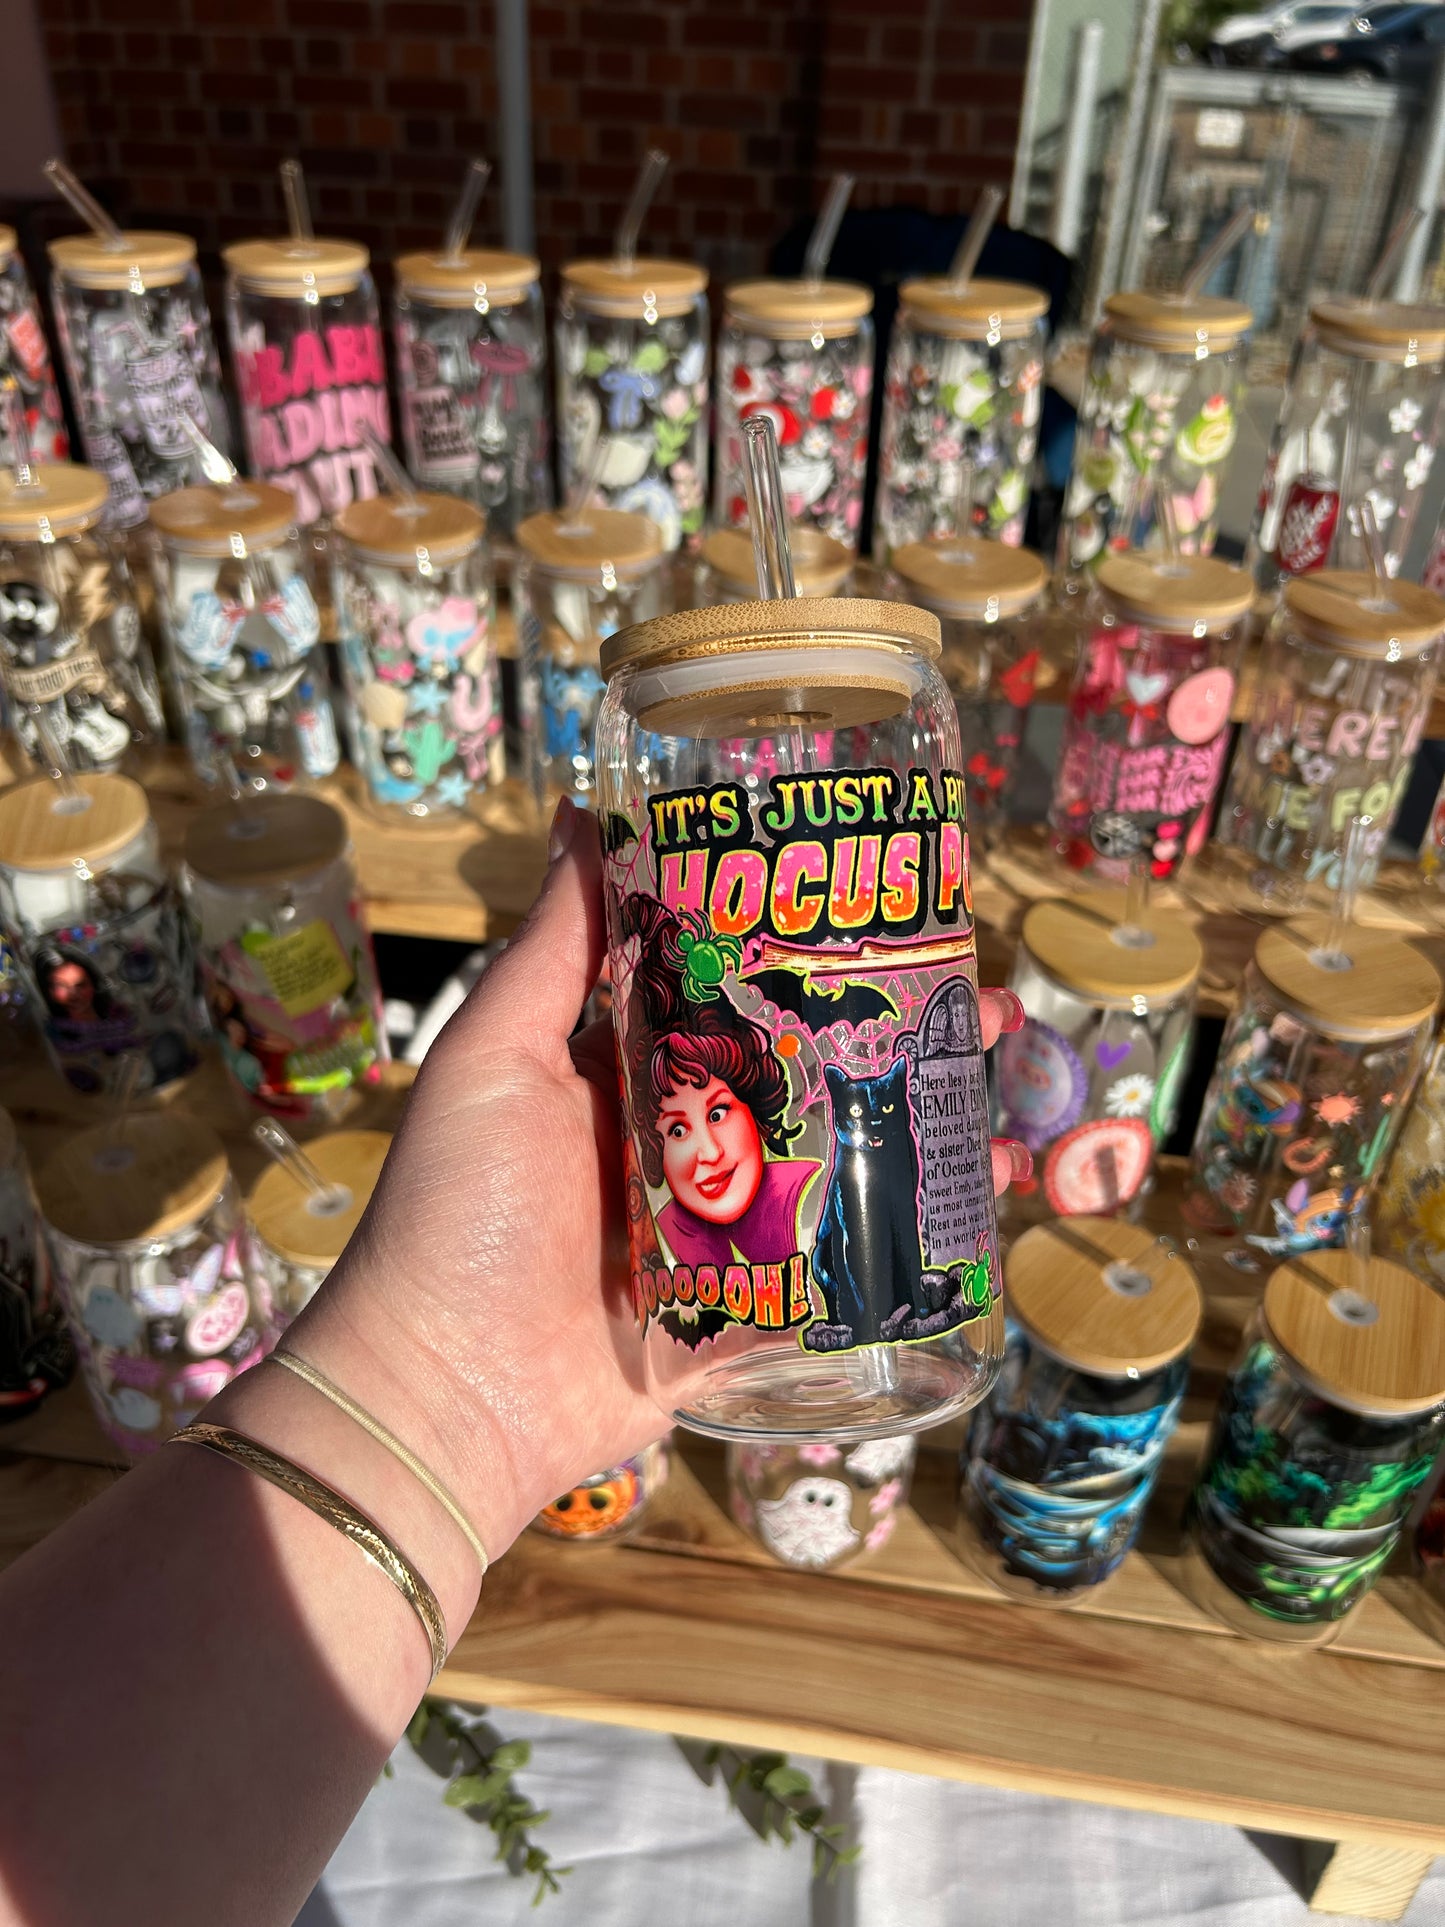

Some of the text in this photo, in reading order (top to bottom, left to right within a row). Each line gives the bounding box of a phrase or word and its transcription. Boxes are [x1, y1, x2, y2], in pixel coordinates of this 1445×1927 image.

[652, 789, 740, 846] IT'S
[765, 775, 893, 831] JUST
[908, 774, 938, 820] A
[660, 831, 922, 936] HOCUS
[920, 1073, 946, 1091] Here
[947, 1071, 962, 1088] lies
[922, 1090, 967, 1119] EMILY
[925, 1118, 965, 1138] beloved
[926, 1149, 937, 1160] &
[938, 1143, 965, 1159] sister
[926, 1162, 941, 1180] of
[942, 1157, 979, 1178] October
[929, 1186, 953, 1199] sweet
[929, 1205, 941, 1215] us
[943, 1200, 963, 1214] most
[930, 1218, 950, 1232] Rest
[953, 1212, 968, 1228] and
[945, 1237, 951, 1247] a
[952, 1227, 976, 1245] world
